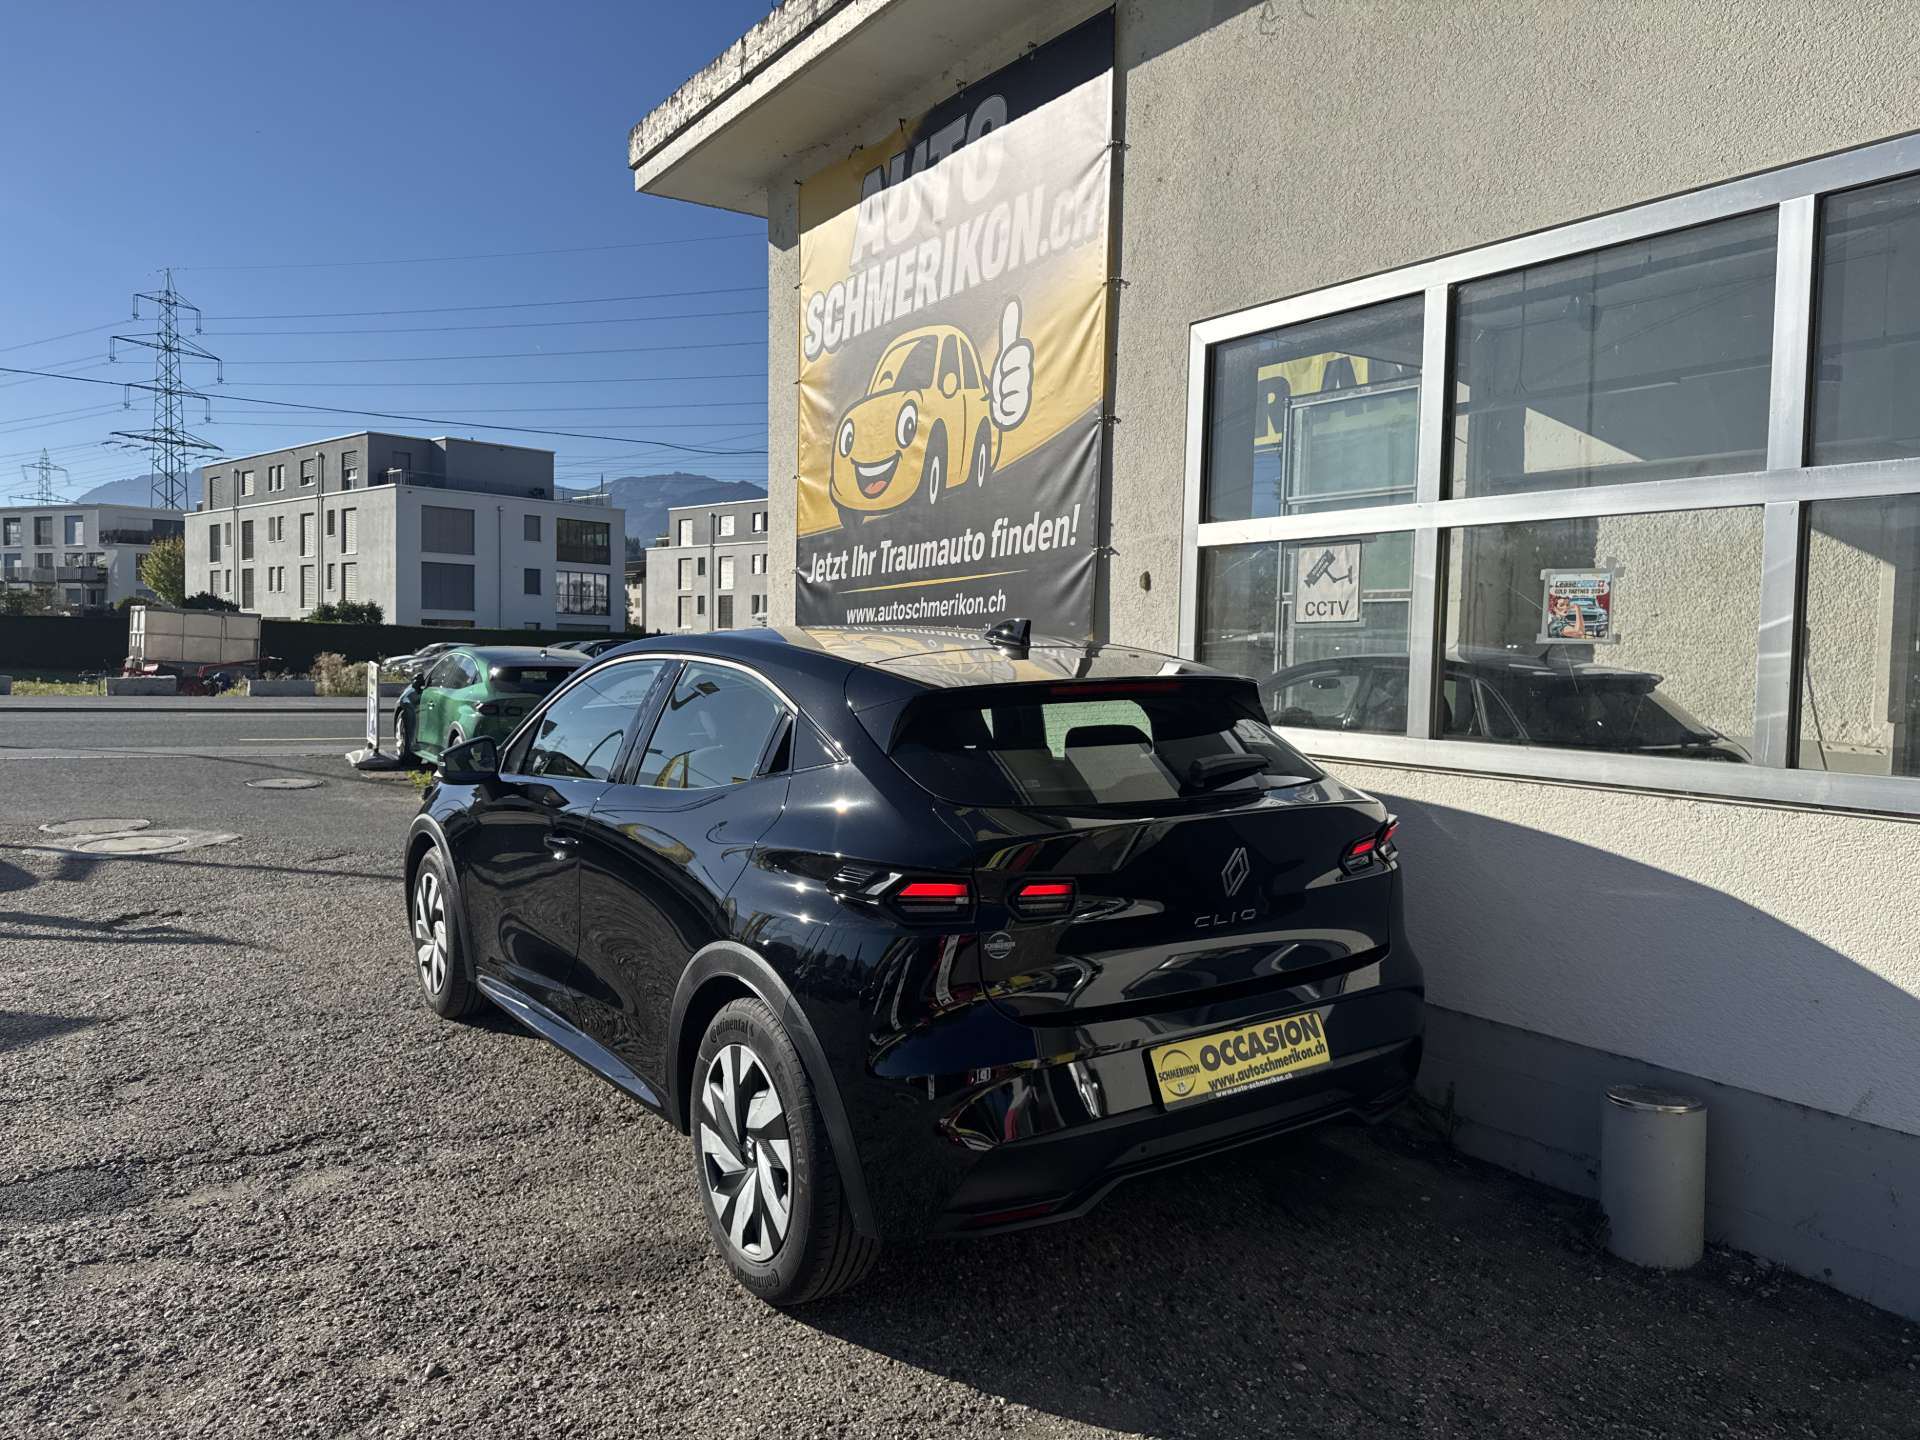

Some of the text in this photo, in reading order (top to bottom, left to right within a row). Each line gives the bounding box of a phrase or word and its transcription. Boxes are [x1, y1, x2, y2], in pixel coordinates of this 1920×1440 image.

[850, 95, 1008, 267] AUTO
[806, 503, 1081, 584] Jetzt Ihr Traumauto finden!
[846, 589, 1006, 625] www.autoschmerikon.ch
[1305, 600, 1349, 616] CCTV
[1195, 909, 1256, 928] CLIO
[710, 1018, 748, 1043] Continental
[1200, 1013, 1321, 1071] OCCASION
[1158, 1064, 1200, 1082] SCHMERIKON
[1208, 1040, 1326, 1091] www.autoschmerikon.ch
